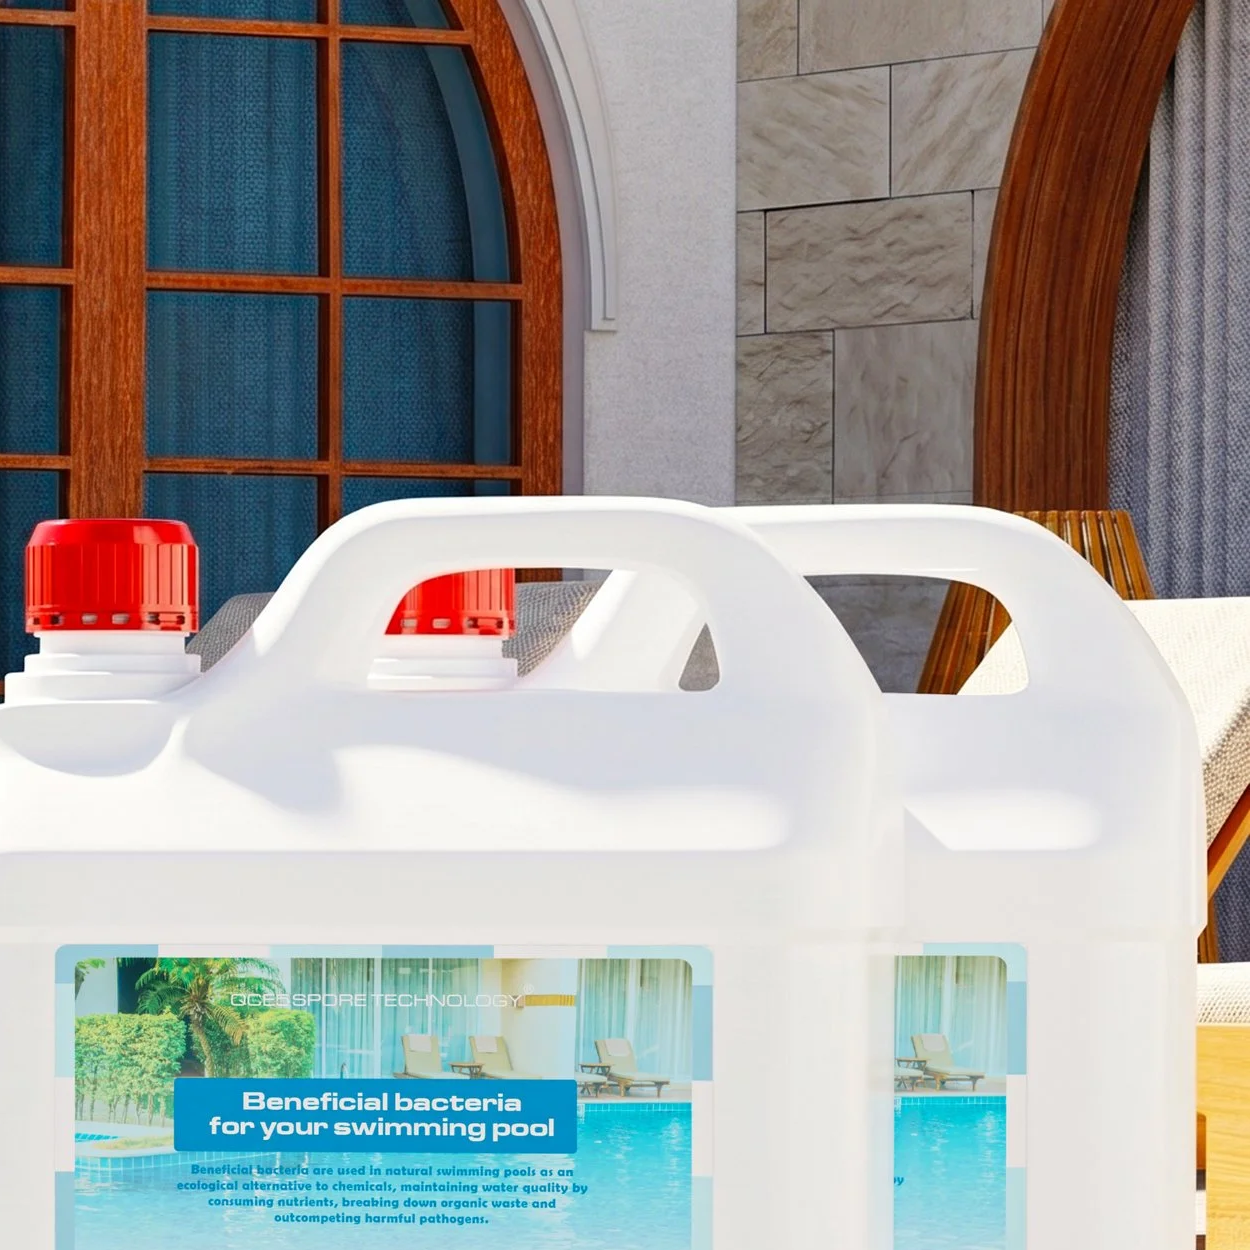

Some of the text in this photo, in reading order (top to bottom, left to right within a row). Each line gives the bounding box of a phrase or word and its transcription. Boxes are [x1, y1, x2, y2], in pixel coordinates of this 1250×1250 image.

[242, 1091, 521, 1112] Beneficial bacteria
[208, 1115, 554, 1142] for your swimming pool
[190, 1163, 574, 1178] Beneficial bacteria are used in natural swimming pools as an
[174, 1178, 588, 1195] ecological alternative to chemicals, maintaining water quality by
[207, 1195, 556, 1210] consuming nutrients, breaking down organic waste and
[273, 1211, 489, 1226] outcompeting harmful pathogens.
